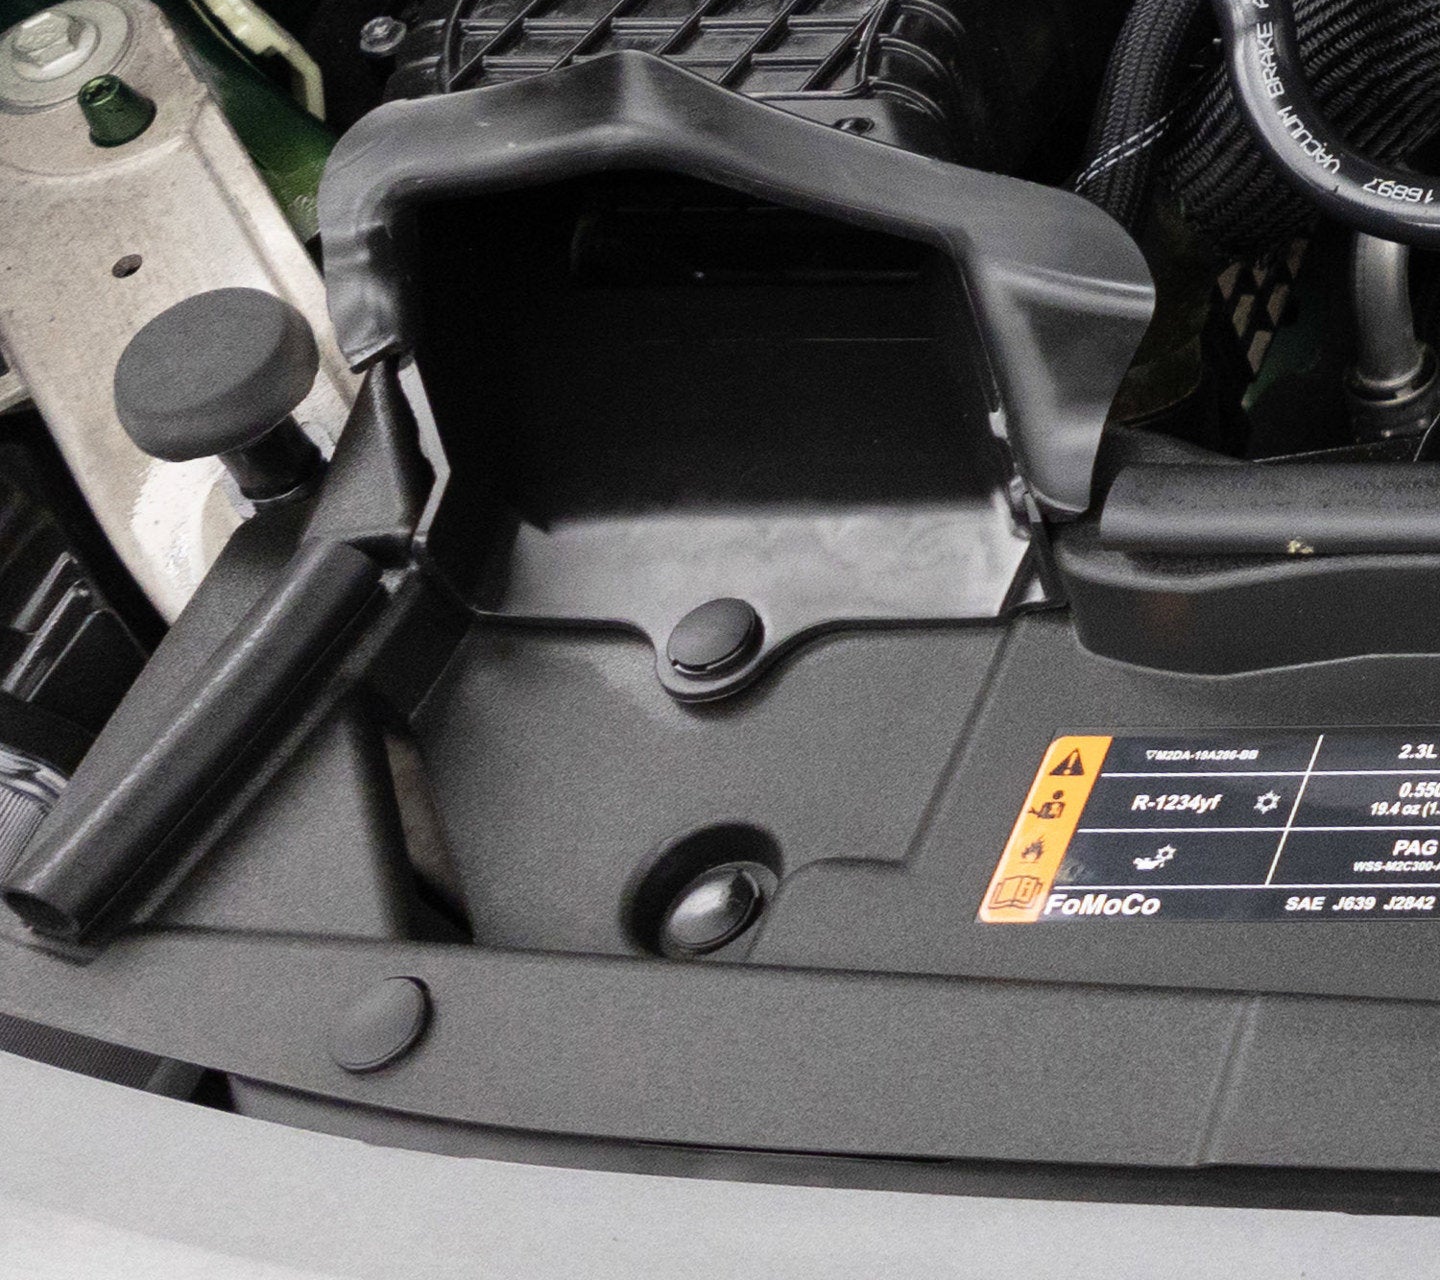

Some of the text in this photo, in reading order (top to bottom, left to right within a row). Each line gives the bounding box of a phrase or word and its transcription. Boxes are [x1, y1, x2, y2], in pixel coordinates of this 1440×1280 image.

[1256, 21, 1285, 97] BRAKE
[1276, 105, 1340, 175] VACUUM
[1362, 177, 1435, 204] 16897
[1398, 743, 1438, 759] 2.3L
[1131, 795, 1222, 812] R-1234yf
[1369, 802, 1400, 816] 19.4
[1402, 804, 1421, 816] oz
[1392, 839, 1439, 857] PAG
[1045, 892, 1161, 917] FoMoCo
[1285, 896, 1323, 912] SAE
[1332, 896, 1377, 912] J639
[1383, 896, 1437, 912] J2842
